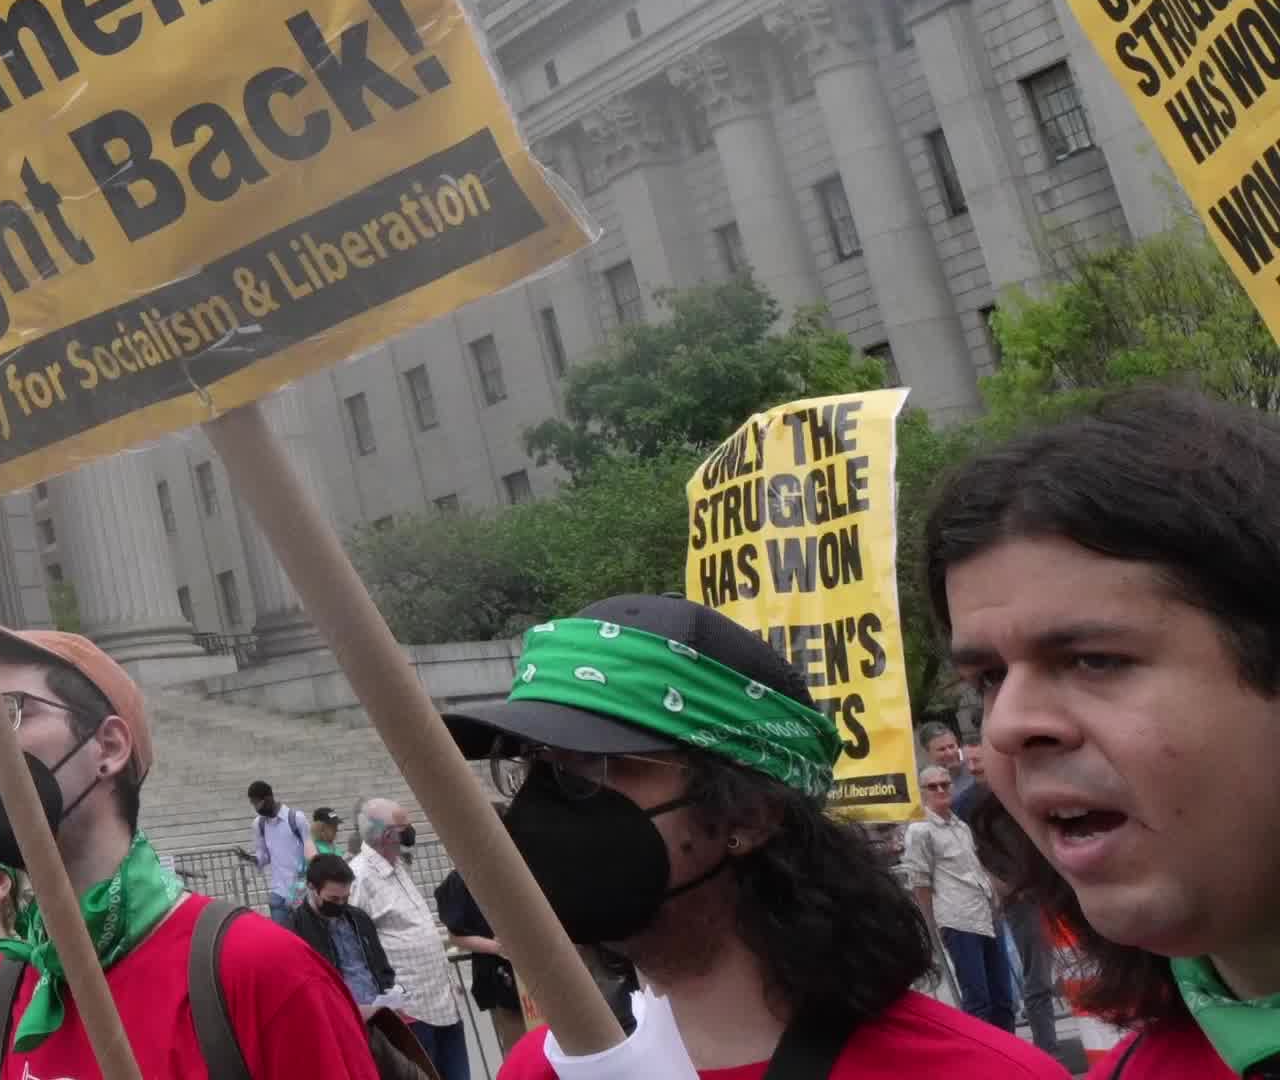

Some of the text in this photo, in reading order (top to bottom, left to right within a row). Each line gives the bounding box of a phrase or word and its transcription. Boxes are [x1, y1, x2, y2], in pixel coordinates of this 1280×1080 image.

[1164, 60, 1237, 165] HAS
[4, 360, 67, 416] for
[66, 290, 237, 390] Socialism
[231, 265, 279, 319] &
[267, 168, 492, 301] Liberation
[701, 400, 865, 492] ONLY THE
[690, 454, 870, 551] STRUGGLE
[699, 524, 864, 609] HAS WON
[843, 781, 897, 798] Liberation
